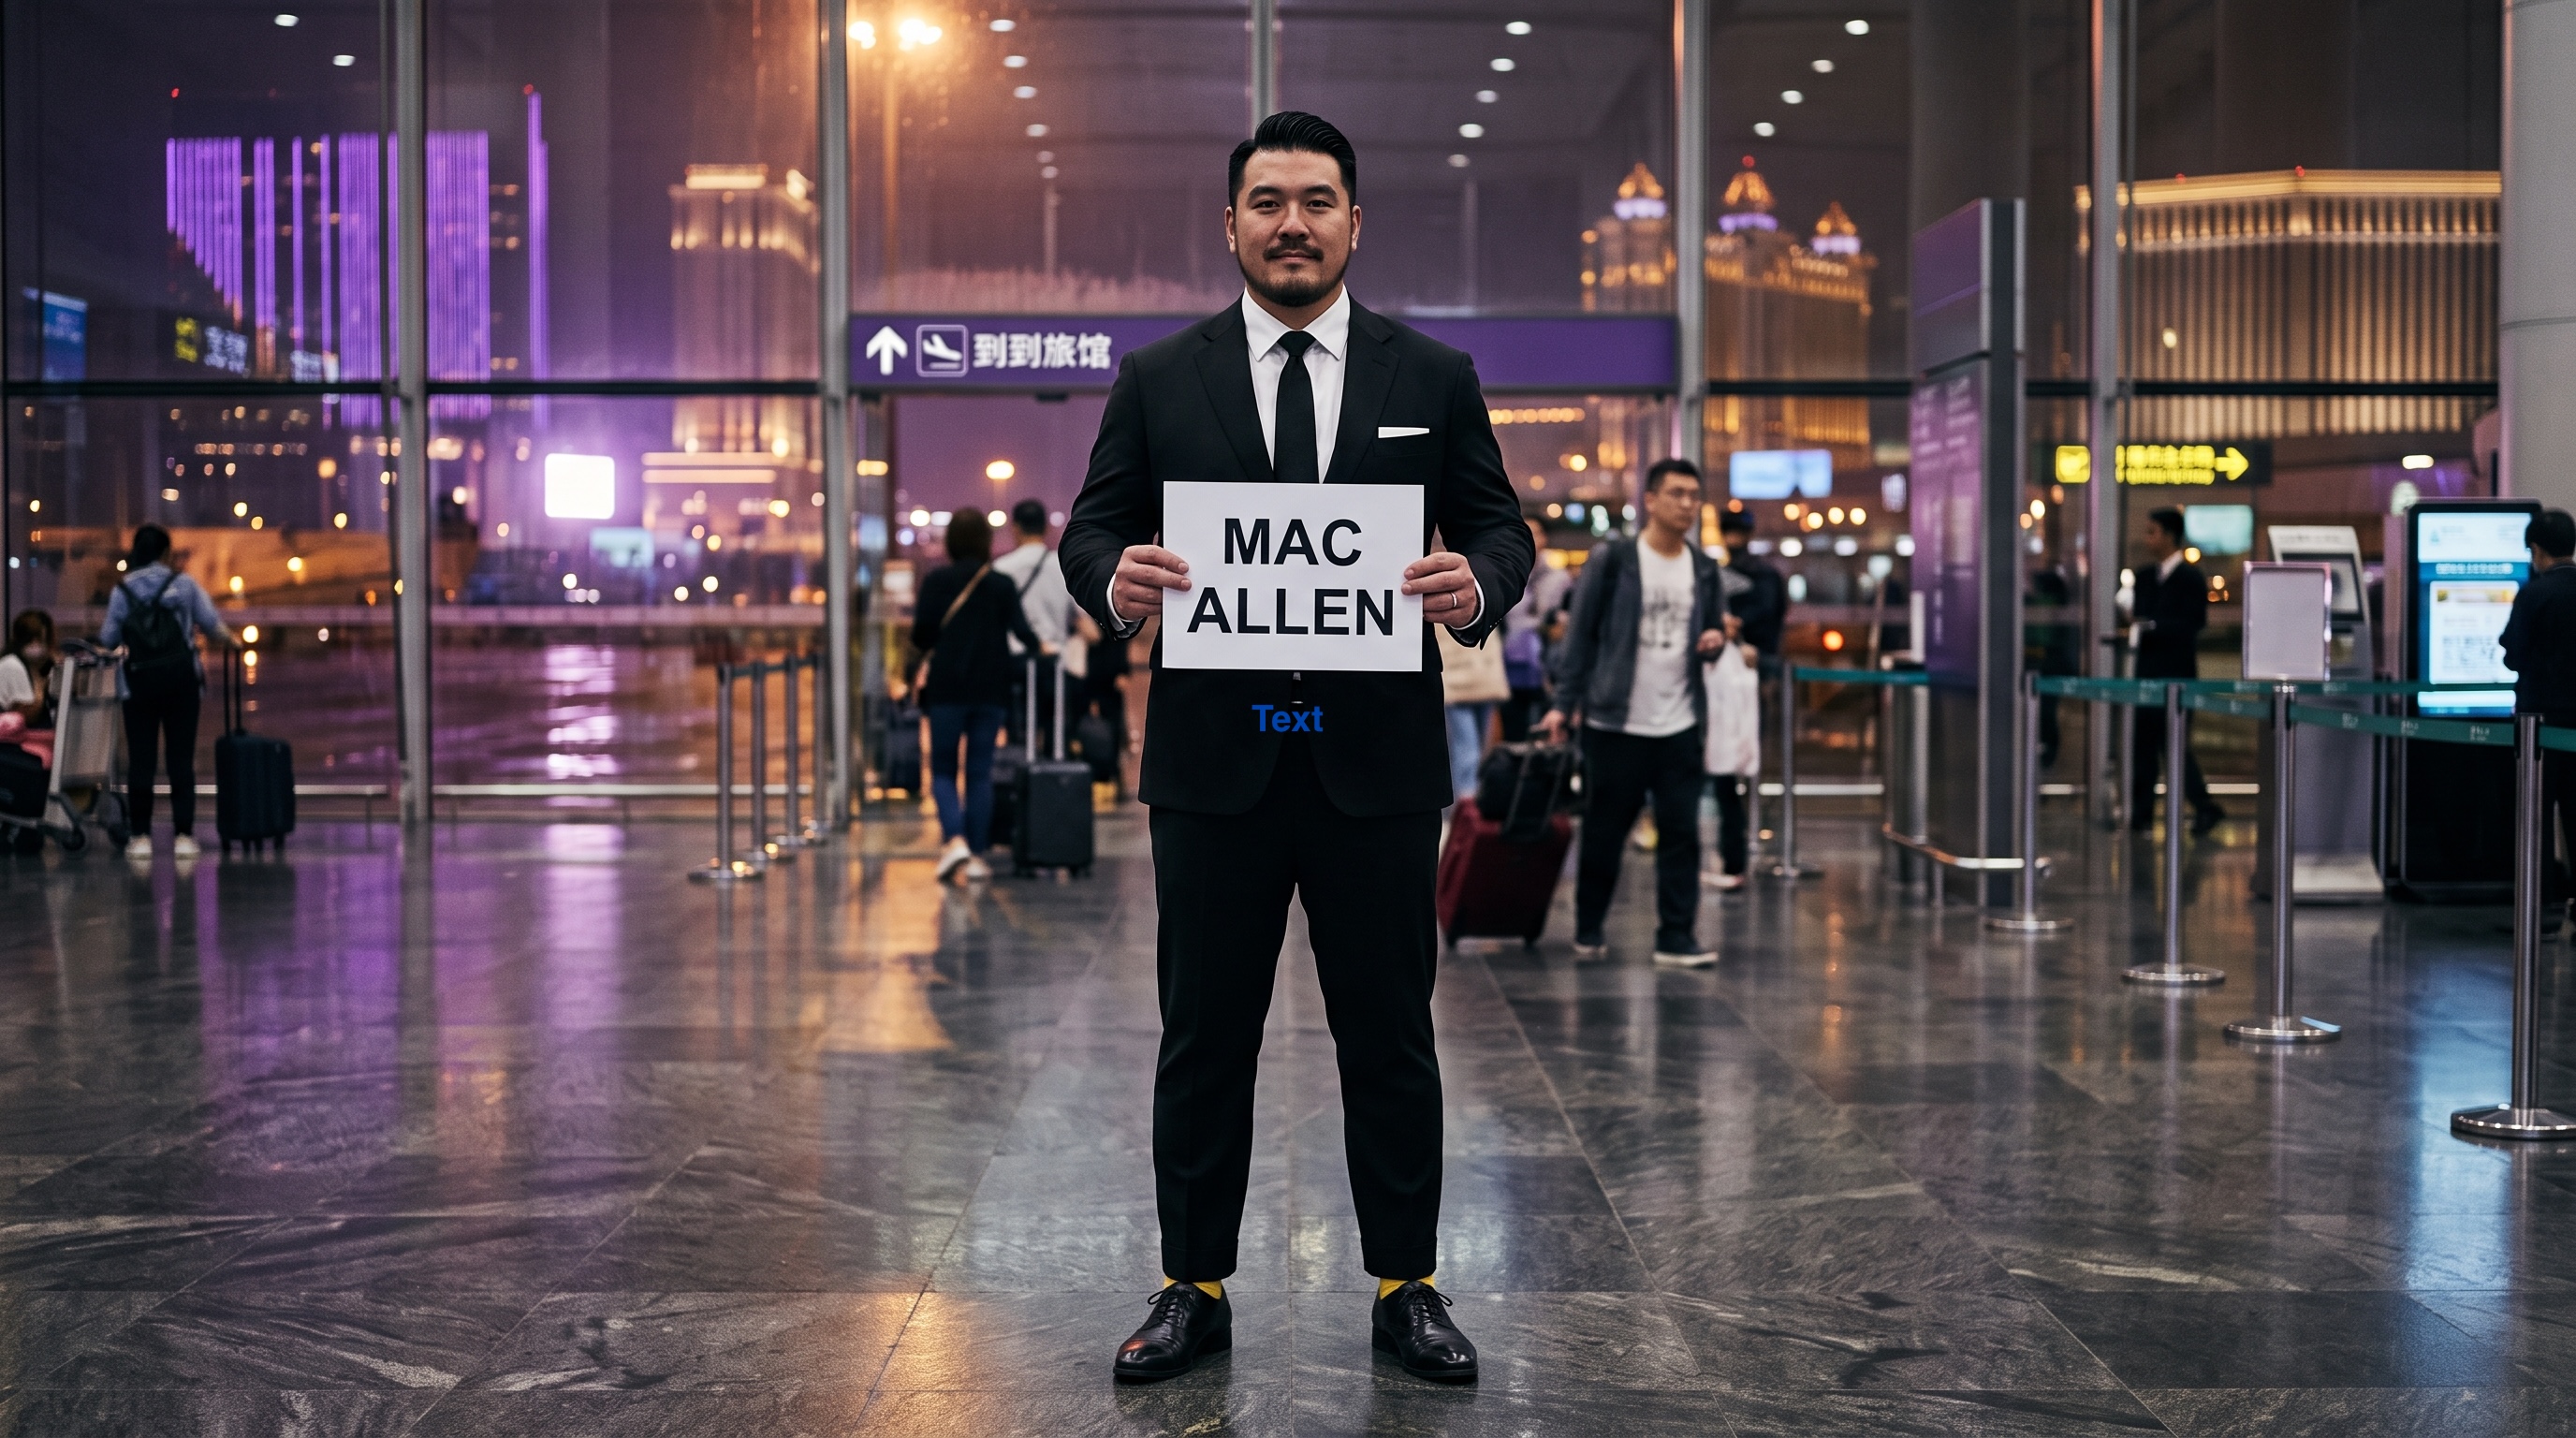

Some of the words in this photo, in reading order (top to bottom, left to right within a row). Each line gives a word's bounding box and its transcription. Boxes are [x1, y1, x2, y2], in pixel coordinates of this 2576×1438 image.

[973, 332, 1112, 369] 到到旅馆
[1224, 518, 1362, 566] MAC
[1187, 586, 1393, 636] ALLEN
